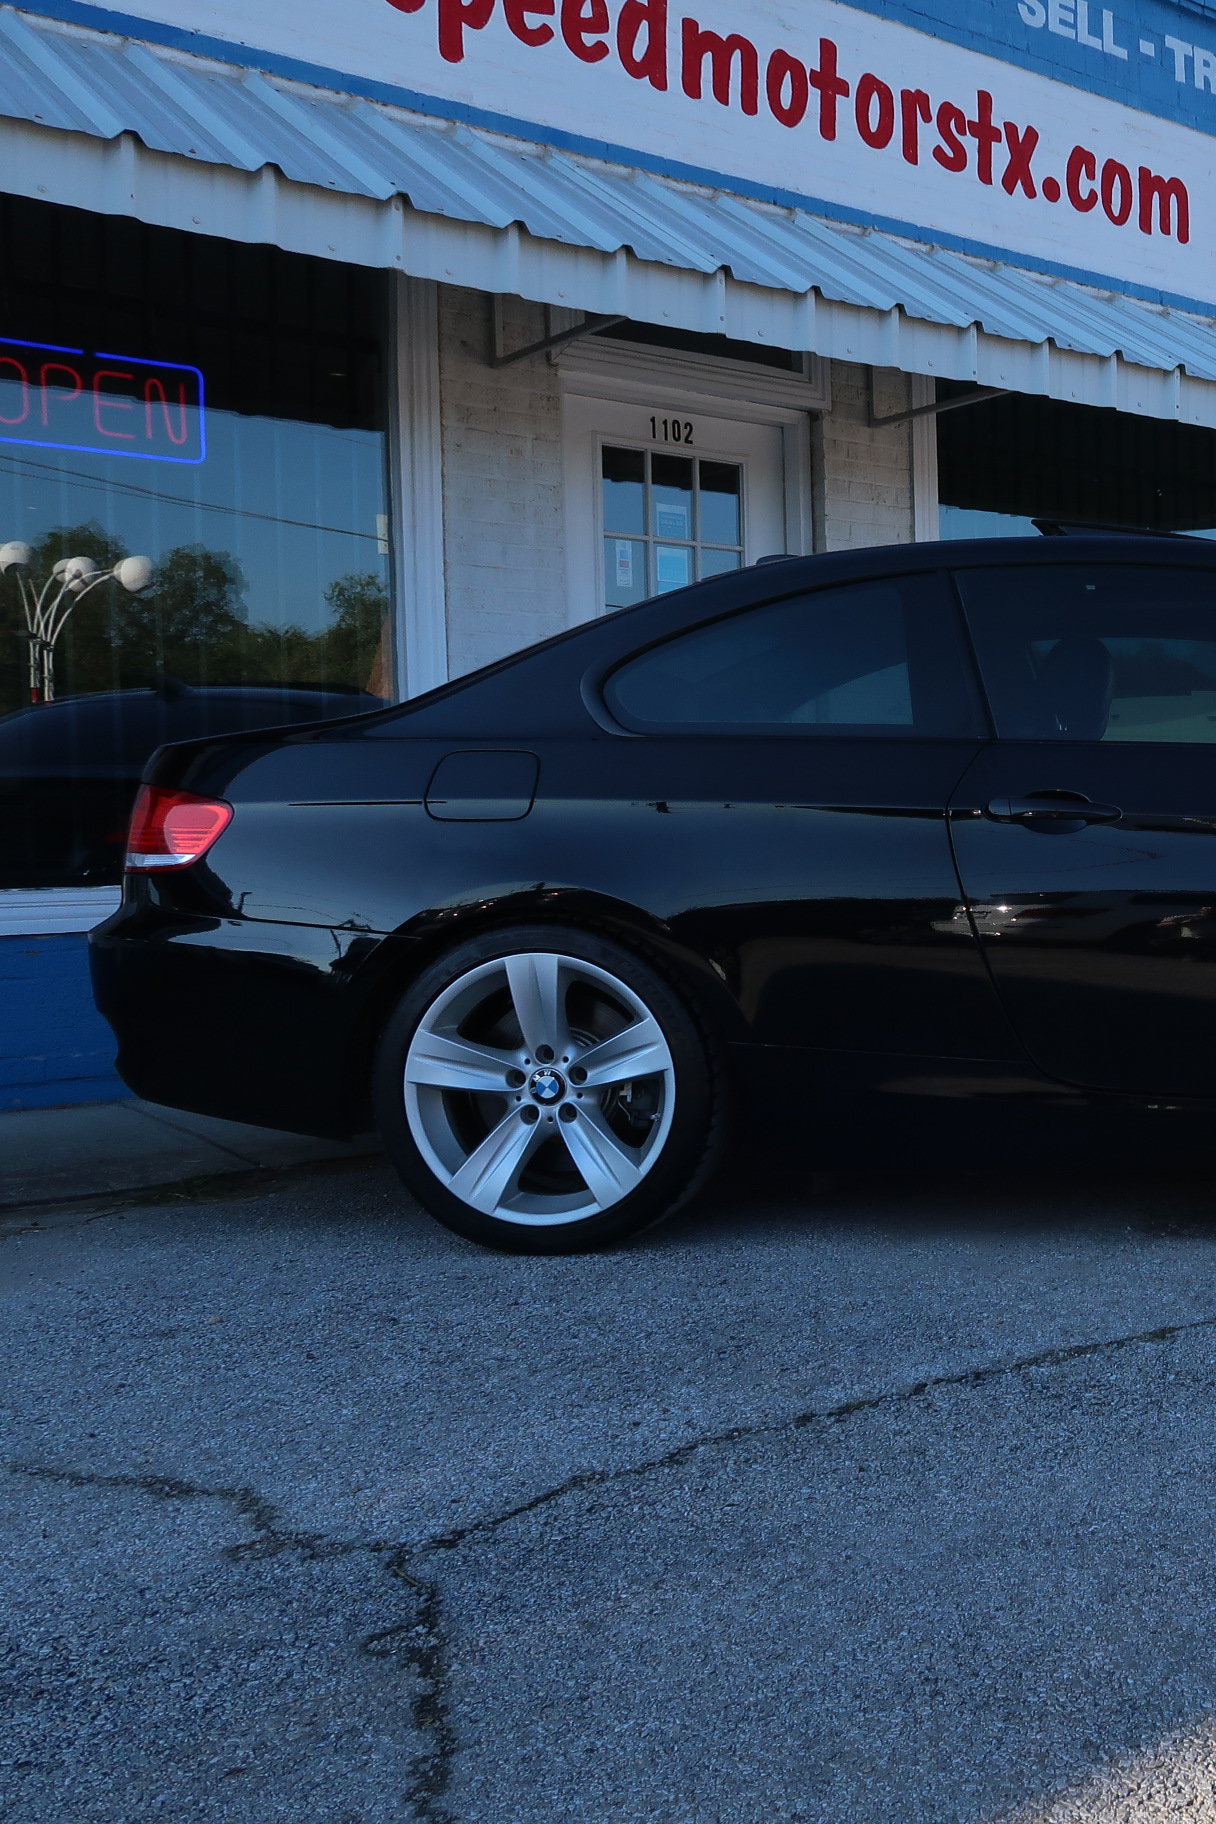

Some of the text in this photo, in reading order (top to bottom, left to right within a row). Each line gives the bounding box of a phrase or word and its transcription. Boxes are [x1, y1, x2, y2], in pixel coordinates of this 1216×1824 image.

[1017, 0, 1128, 61] SELL
[385, 0, 1190, 244] peedmotorstx.com
[0, 355, 188, 445] OPEN
[650, 416, 694, 444] 1102
